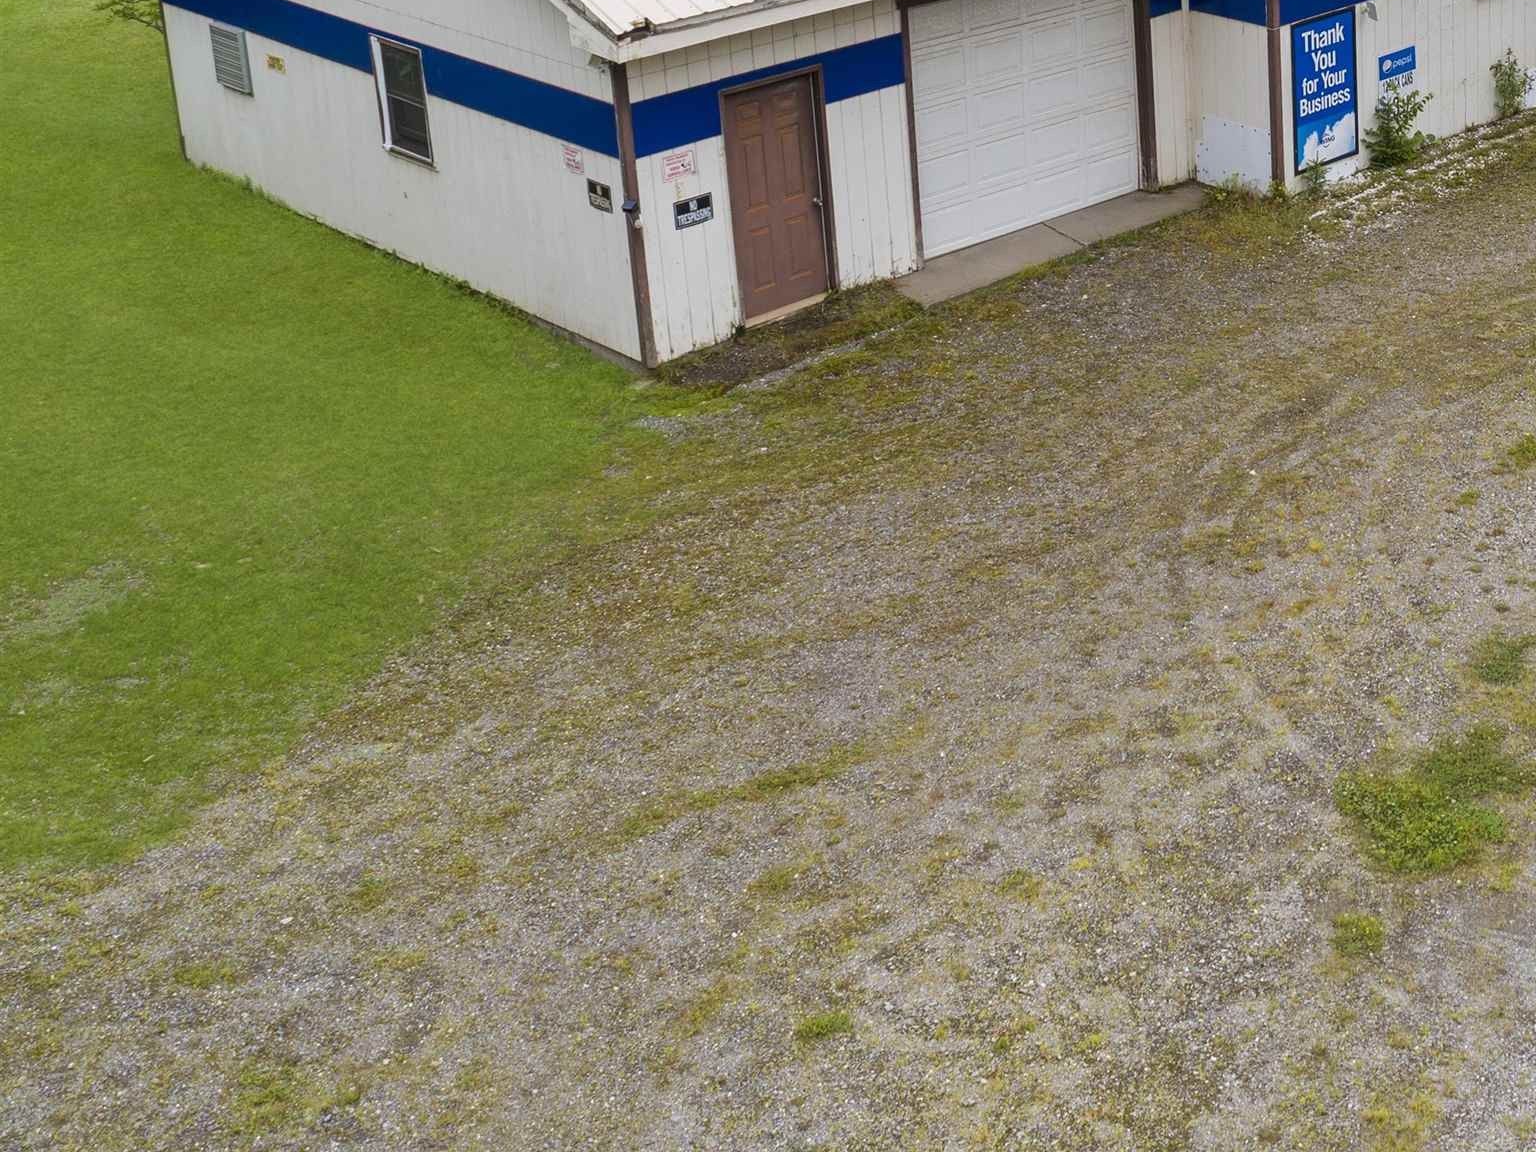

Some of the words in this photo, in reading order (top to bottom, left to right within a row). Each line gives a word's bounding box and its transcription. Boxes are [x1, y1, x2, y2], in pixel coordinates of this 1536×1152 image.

[1301, 22, 1345, 53] Thank
[1311, 50, 1337, 72] You
[1392, 53, 1412, 69] pepsi
[1302, 77, 1319, 96] for
[1321, 69, 1347, 89] Your
[1300, 88, 1351, 117] Business
